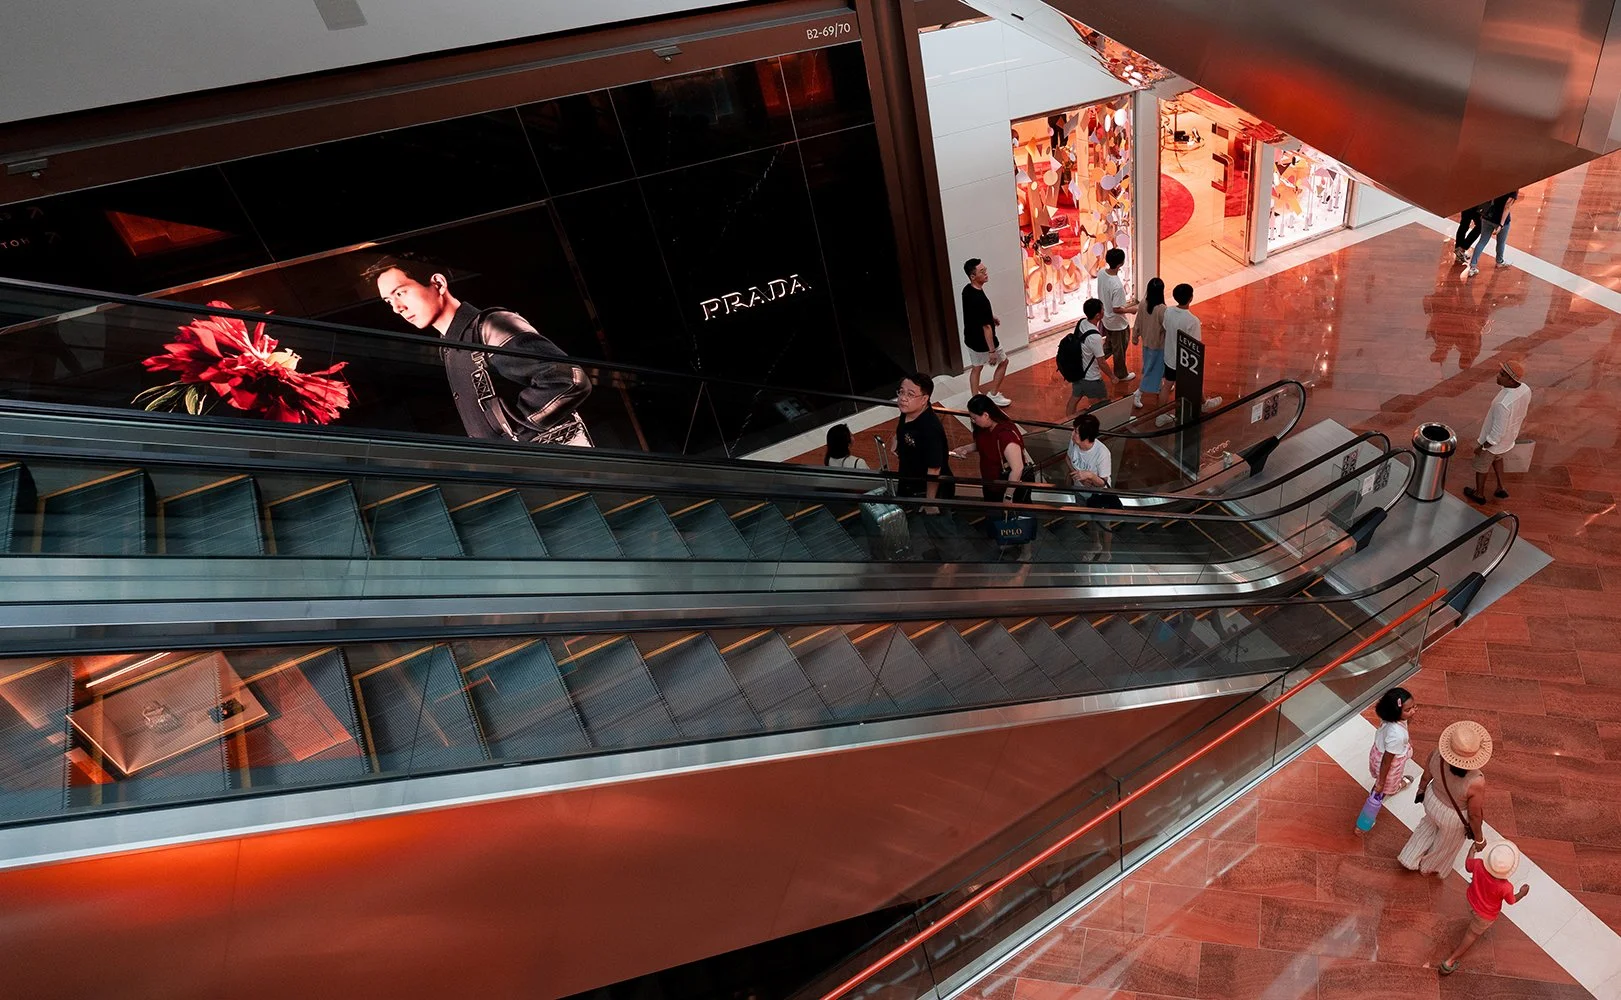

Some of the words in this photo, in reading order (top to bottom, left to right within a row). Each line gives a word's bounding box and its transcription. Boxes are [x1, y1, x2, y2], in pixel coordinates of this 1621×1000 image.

[806, 22, 851, 40] B2-69/70
[699, 273, 812, 321] PRADA
[1179, 334, 1201, 354] LEVEL
[1180, 347, 1199, 376] B2
